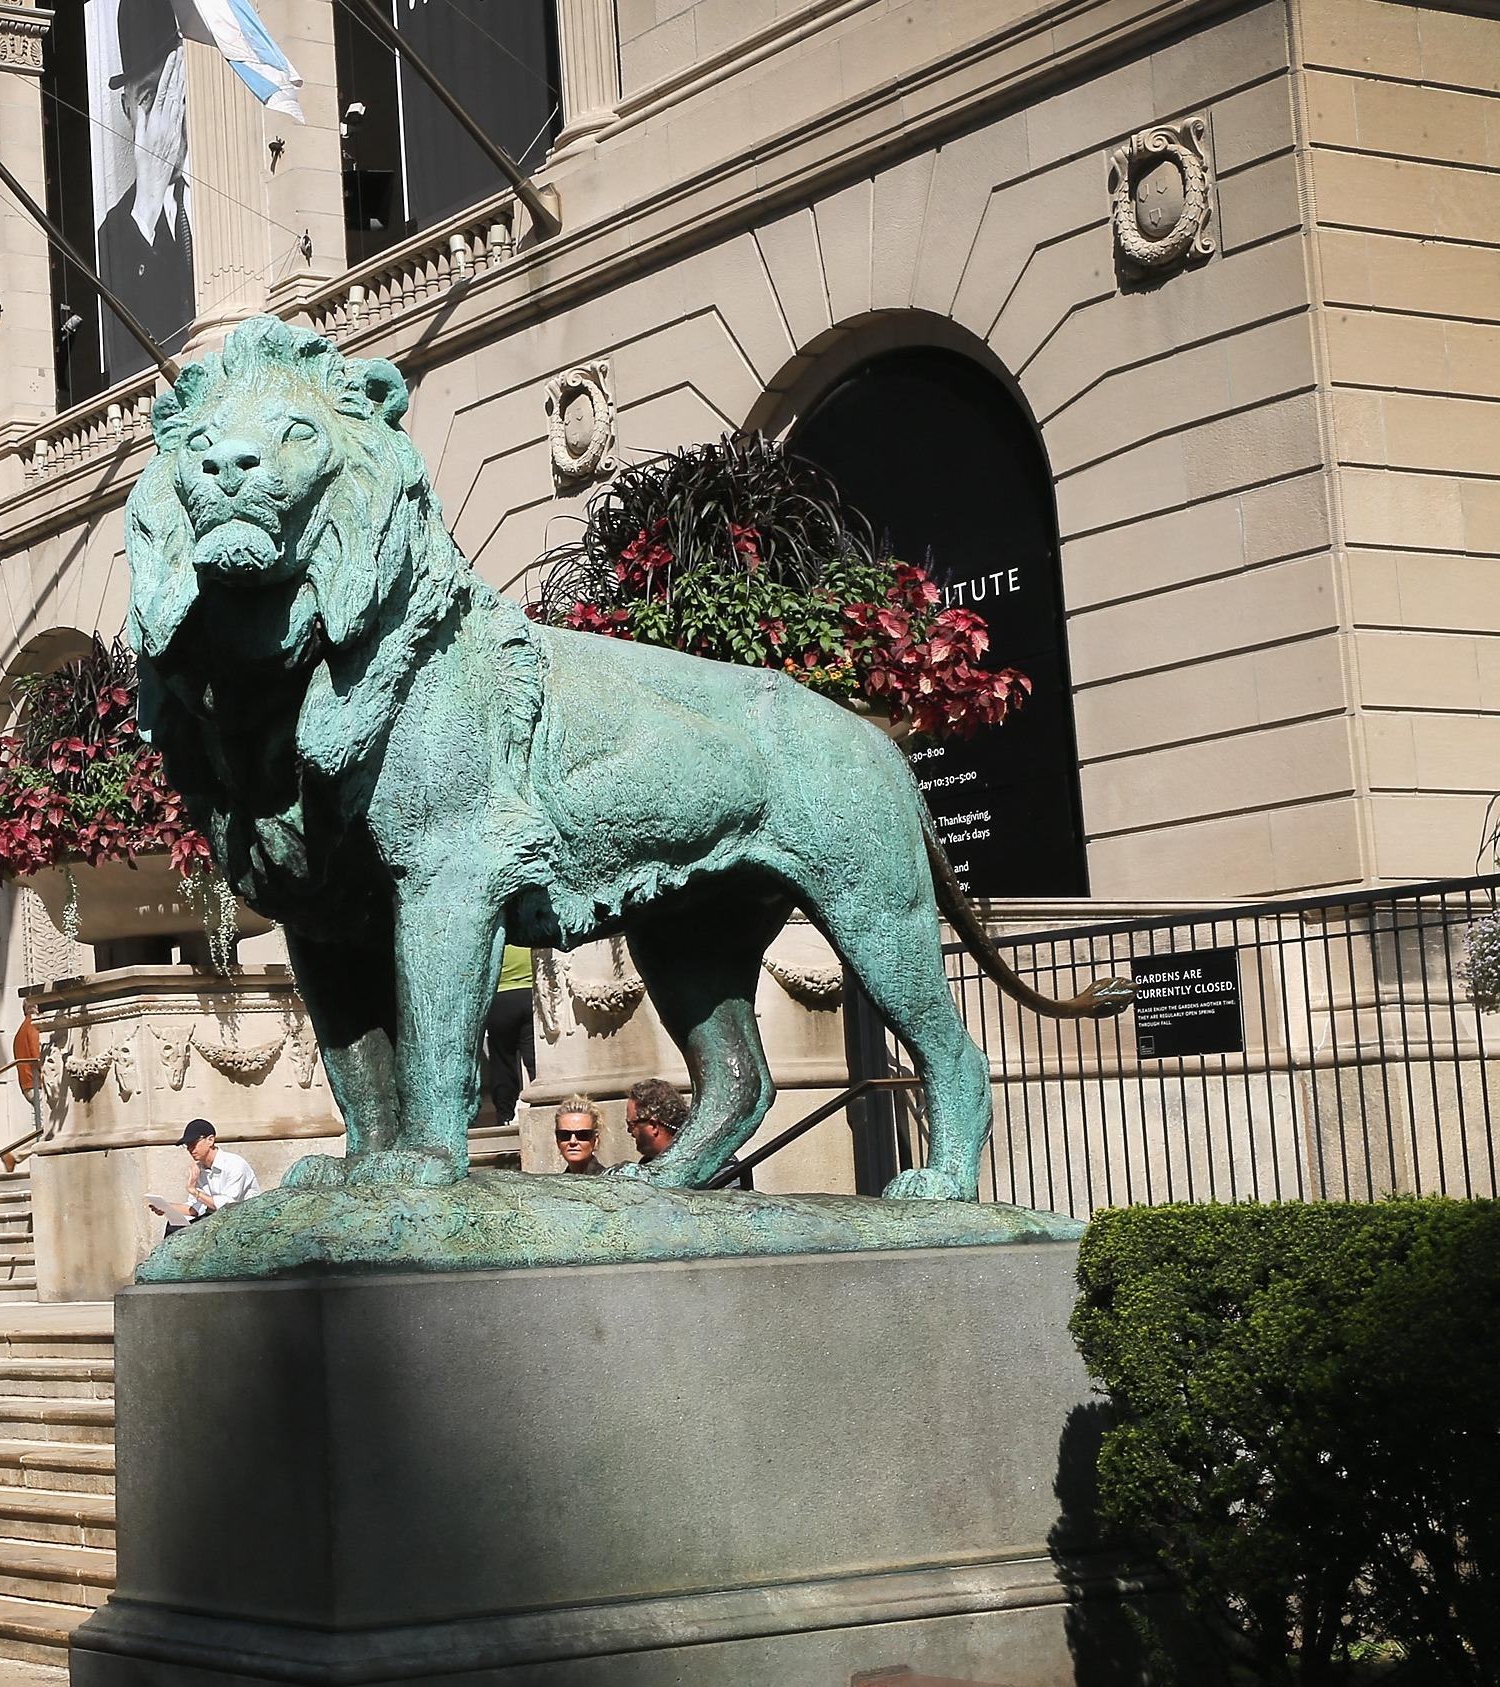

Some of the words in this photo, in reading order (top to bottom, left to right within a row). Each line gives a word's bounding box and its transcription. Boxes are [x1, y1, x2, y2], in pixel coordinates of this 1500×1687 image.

[938, 567, 1021, 608] ITUTE
[972, 828, 991, 840] days
[953, 860, 969, 873] and
[1135, 971, 1180, 984] GARDENS
[1182, 969, 1202, 980] ARE
[1136, 985, 1191, 999] CURRENTLY
[1194, 981, 1235, 994] CLOSED.
